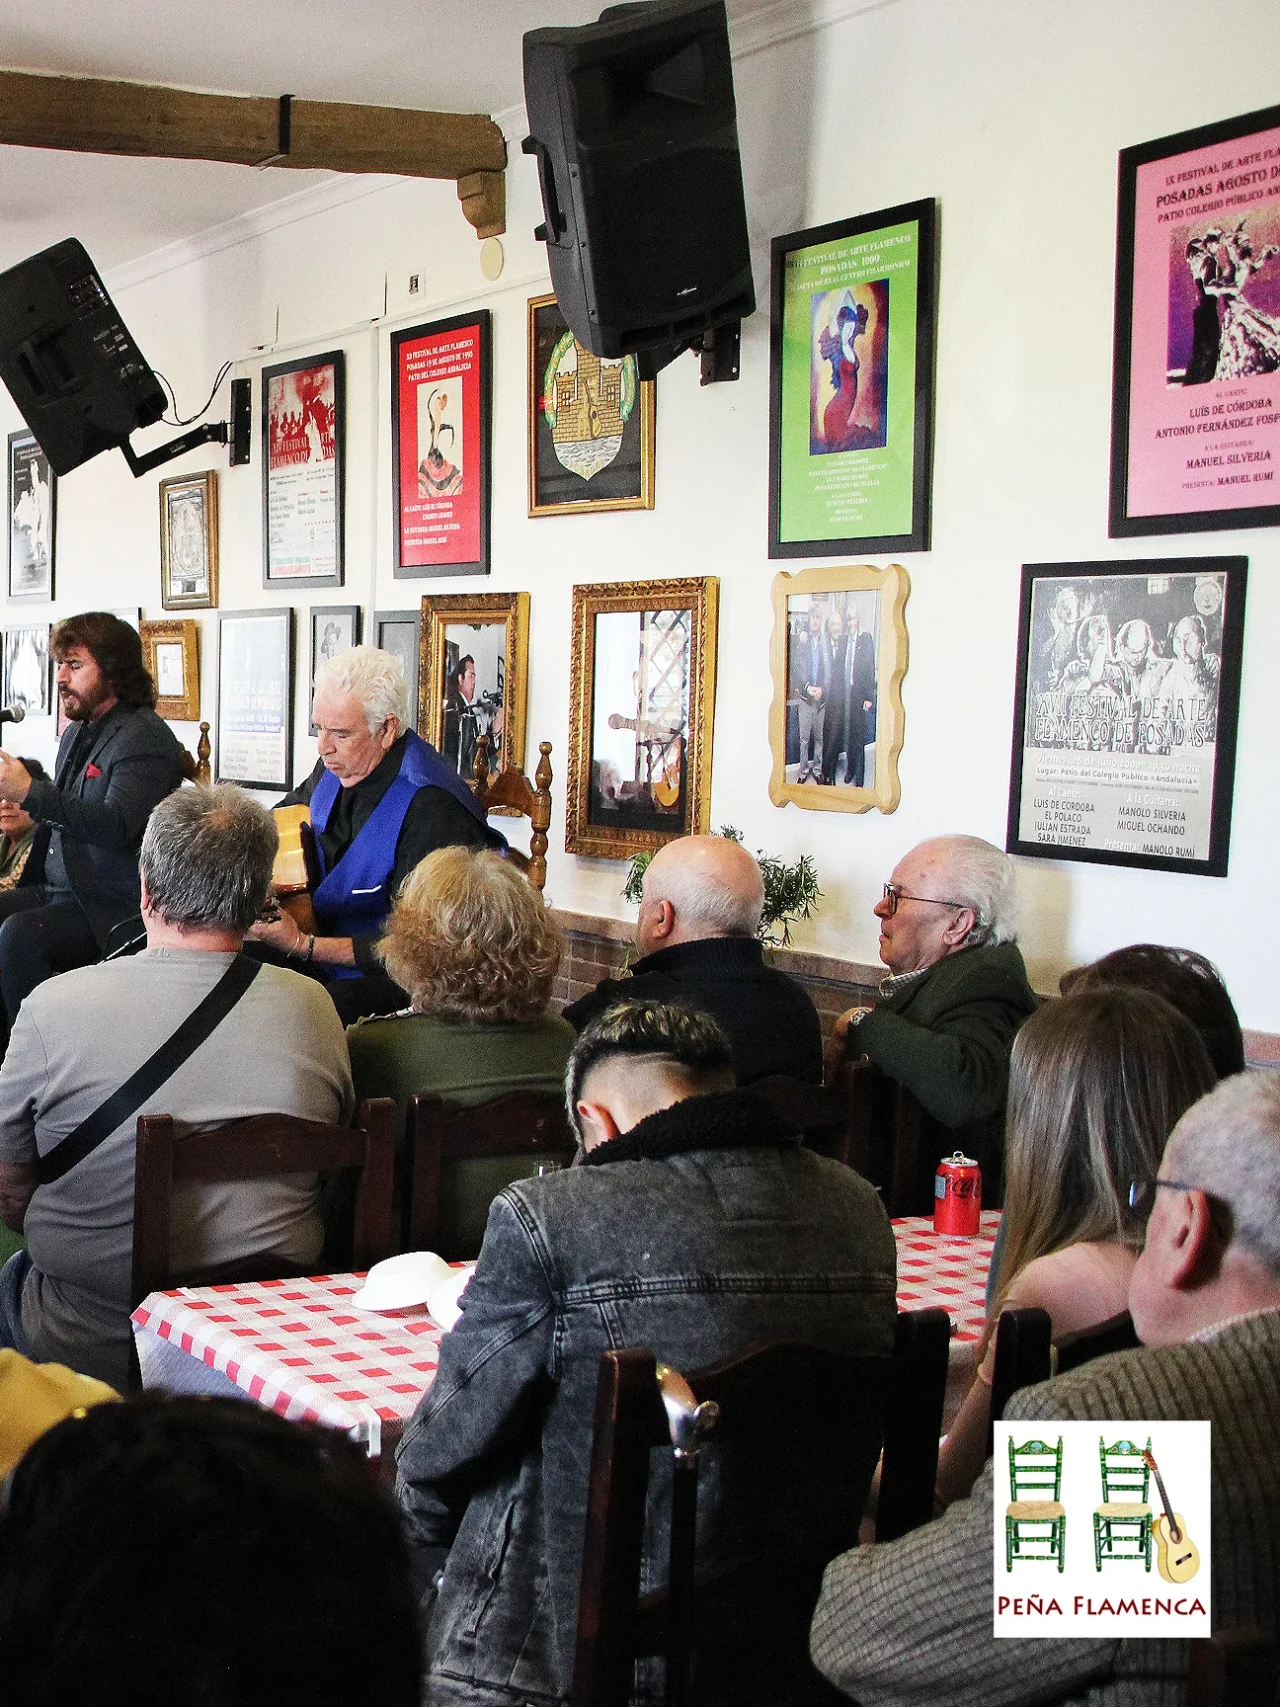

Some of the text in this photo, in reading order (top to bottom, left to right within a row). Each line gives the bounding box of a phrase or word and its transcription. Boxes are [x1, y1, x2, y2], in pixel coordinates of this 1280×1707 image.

[1177, 164, 1219, 182] FESTIVAL
[1222, 161, 1233, 171] DE
[1236, 152, 1261, 167] ARTE
[1156, 183, 1212, 207] POSADAS
[1216, 169, 1267, 193] AGOSTO
[1158, 210, 1184, 223] PATIO
[1185, 200, 1223, 216] COLEGIO
[451, 339, 473, 350] FLAMENCO
[407, 361, 425, 371] POSADAS
[1212, 404, 1225, 415] DE
[1155, 425, 1194, 438] ANTONIO
[1186, 450, 1271, 469] MANUEL SILVERIA
[1217, 475, 1251, 486] MANUEL
[1071, 694, 1137, 720] FESTIVAL
[1142, 697, 1160, 719] DE
[1165, 698, 1206, 721] ARTE
[1035, 718, 1204, 747] FLAMENCO DE POSADAS
[1120, 760, 1141, 769] 2000
[1173, 763, 1200, 773] noche
[1036, 767, 1058, 775] Lugar:
[1061, 768, 1078, 776] Patio
[1093, 770, 1120, 780] Colegio
[1121, 772, 1148, 781] Público
[1048, 786, 1056, 797] Al
[1034, 799, 1048, 808] LUIS
[1050, 801, 1059, 809] DE
[1045, 811, 1082, 823] EL POLACO
[1118, 807, 1186, 821] MANOLO SILVERIA
[1060, 824, 1091, 835] ESTRADA
[1117, 821, 1185, 836] MIGUEL OCHANDO
[1037, 833, 1055, 843] SARA
[1142, 844, 1173, 856] MANOLO
